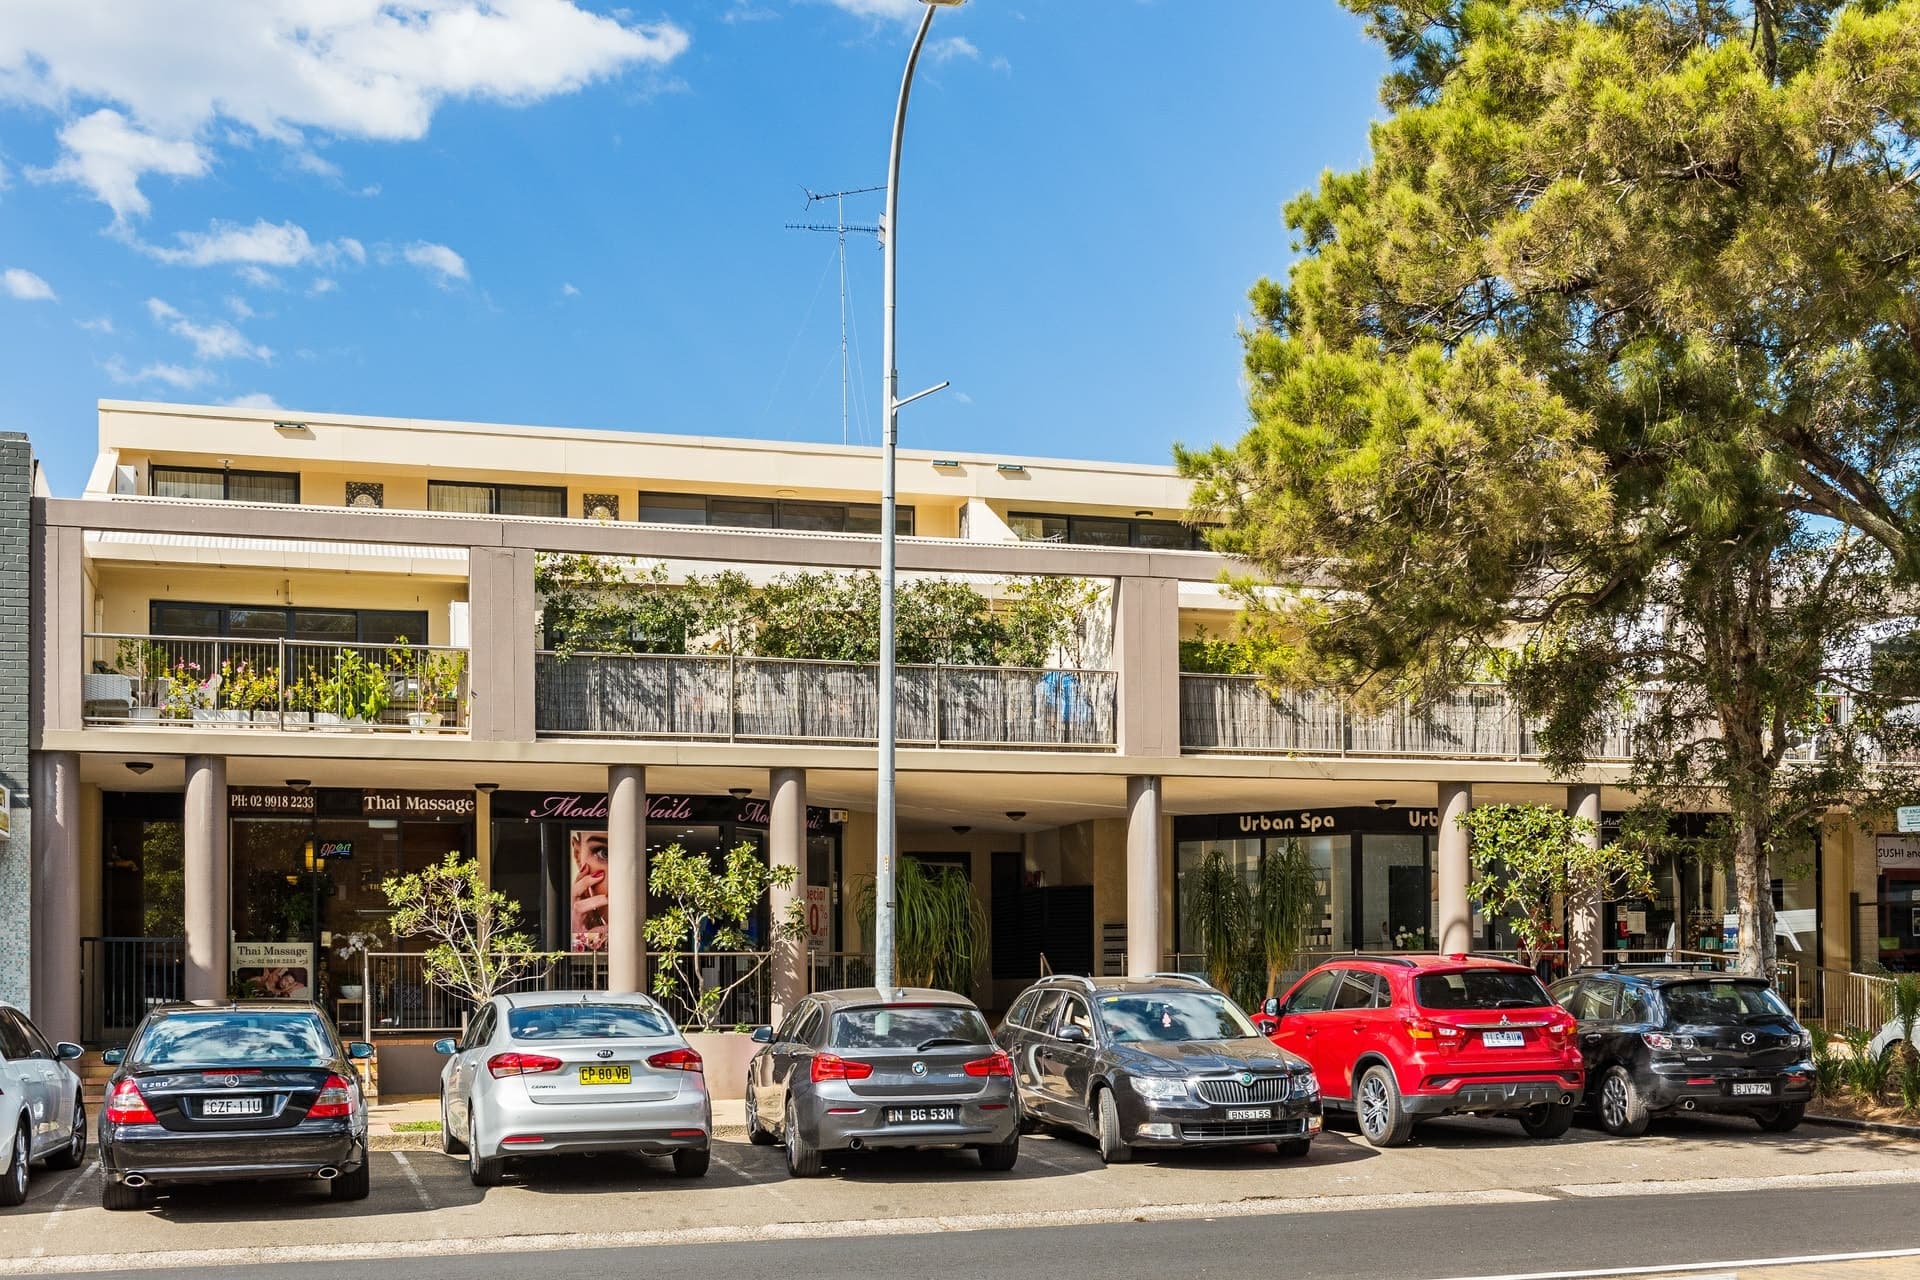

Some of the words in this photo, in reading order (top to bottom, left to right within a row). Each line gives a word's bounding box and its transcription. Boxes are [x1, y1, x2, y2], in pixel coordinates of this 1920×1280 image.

[231, 794, 247, 807] PH:
[250, 795, 262, 807] 02
[264, 795, 288, 808] 9918
[290, 796, 314, 809] 2233
[364, 796, 400, 810] Thai
[405, 796, 475, 813] Massage
[530, 795, 609, 818] Mode
[1239, 815, 1295, 832] Urban
[1300, 812, 1335, 833] Spa
[1409, 811, 1439, 828] Urb
[1878, 847, 1904, 858] SUSHI
[237, 946, 261, 956] Thai
[263, 946, 308, 957] Massage
